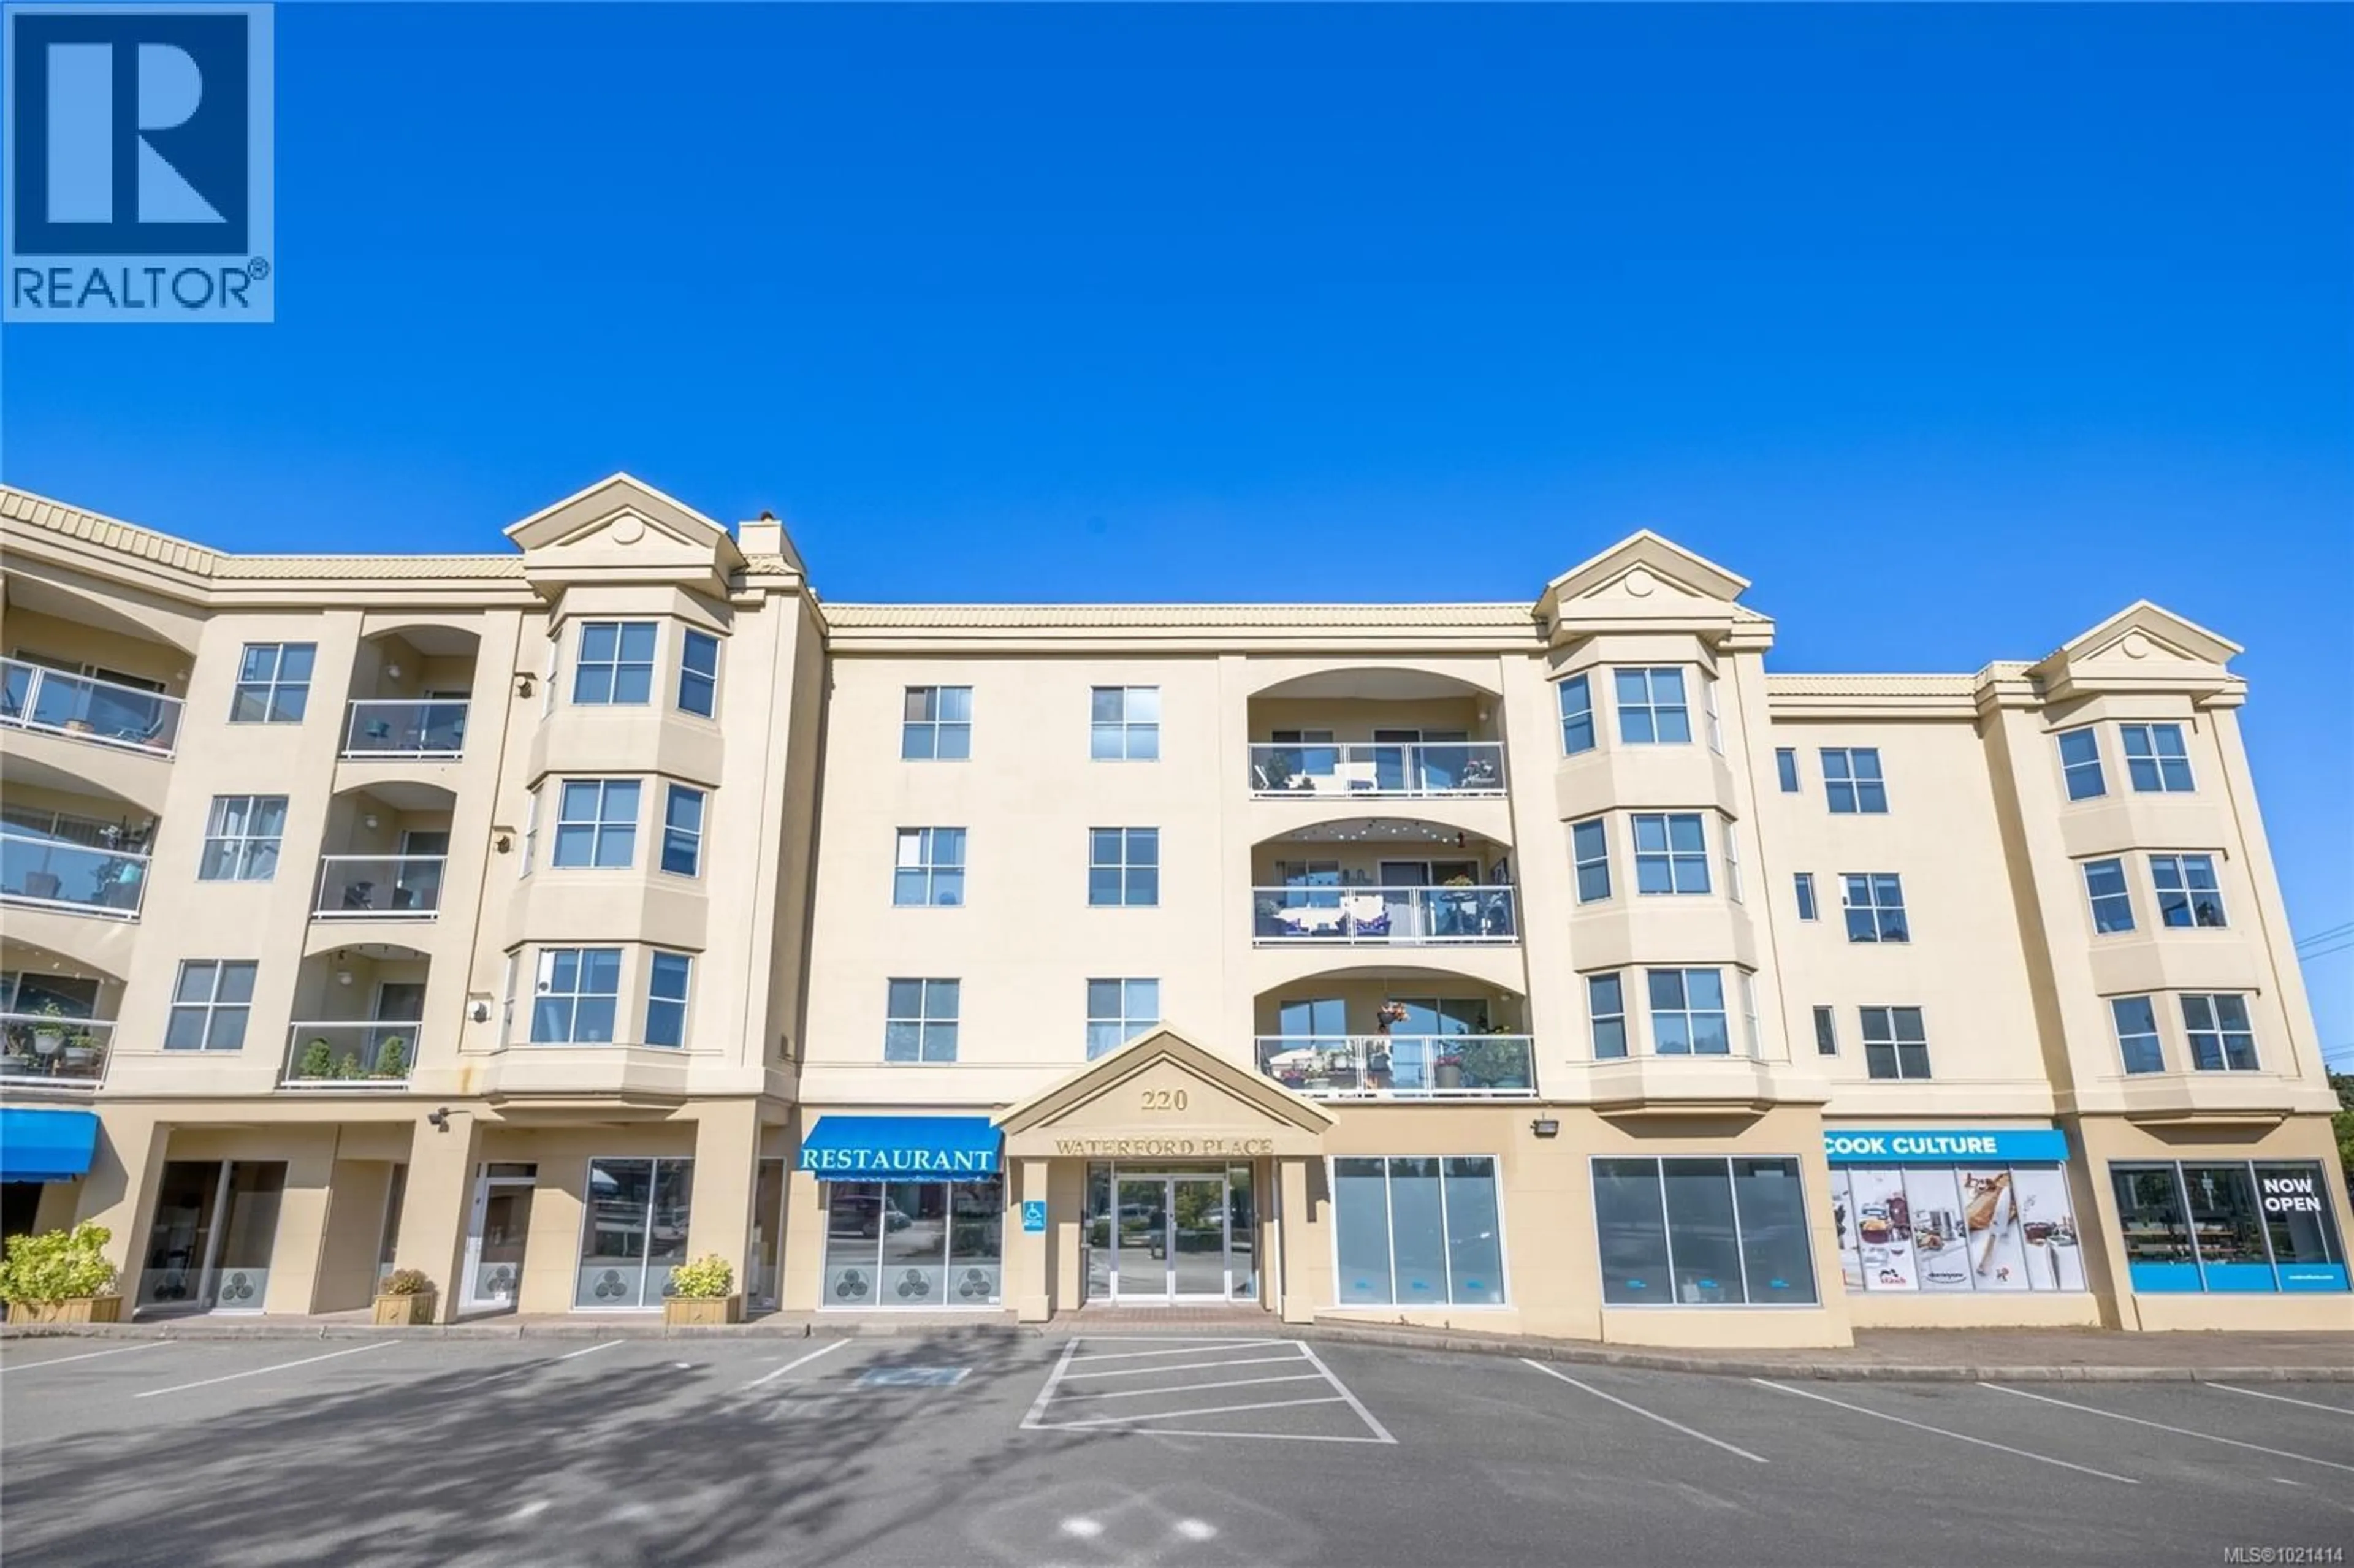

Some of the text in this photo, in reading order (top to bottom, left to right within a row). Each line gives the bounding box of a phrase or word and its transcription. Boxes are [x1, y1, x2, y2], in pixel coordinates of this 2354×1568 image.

[1141, 1090, 1188, 1111] 220
[1056, 1139, 1273, 1155] WATERFORD PLACE
[1824, 1137, 1997, 1154] COOK CULTURE
[801, 1149, 993, 1170] RESTAURANT
[2263, 1178, 2312, 1193] NOW
[2265, 1197, 2322, 1212] OPEN
